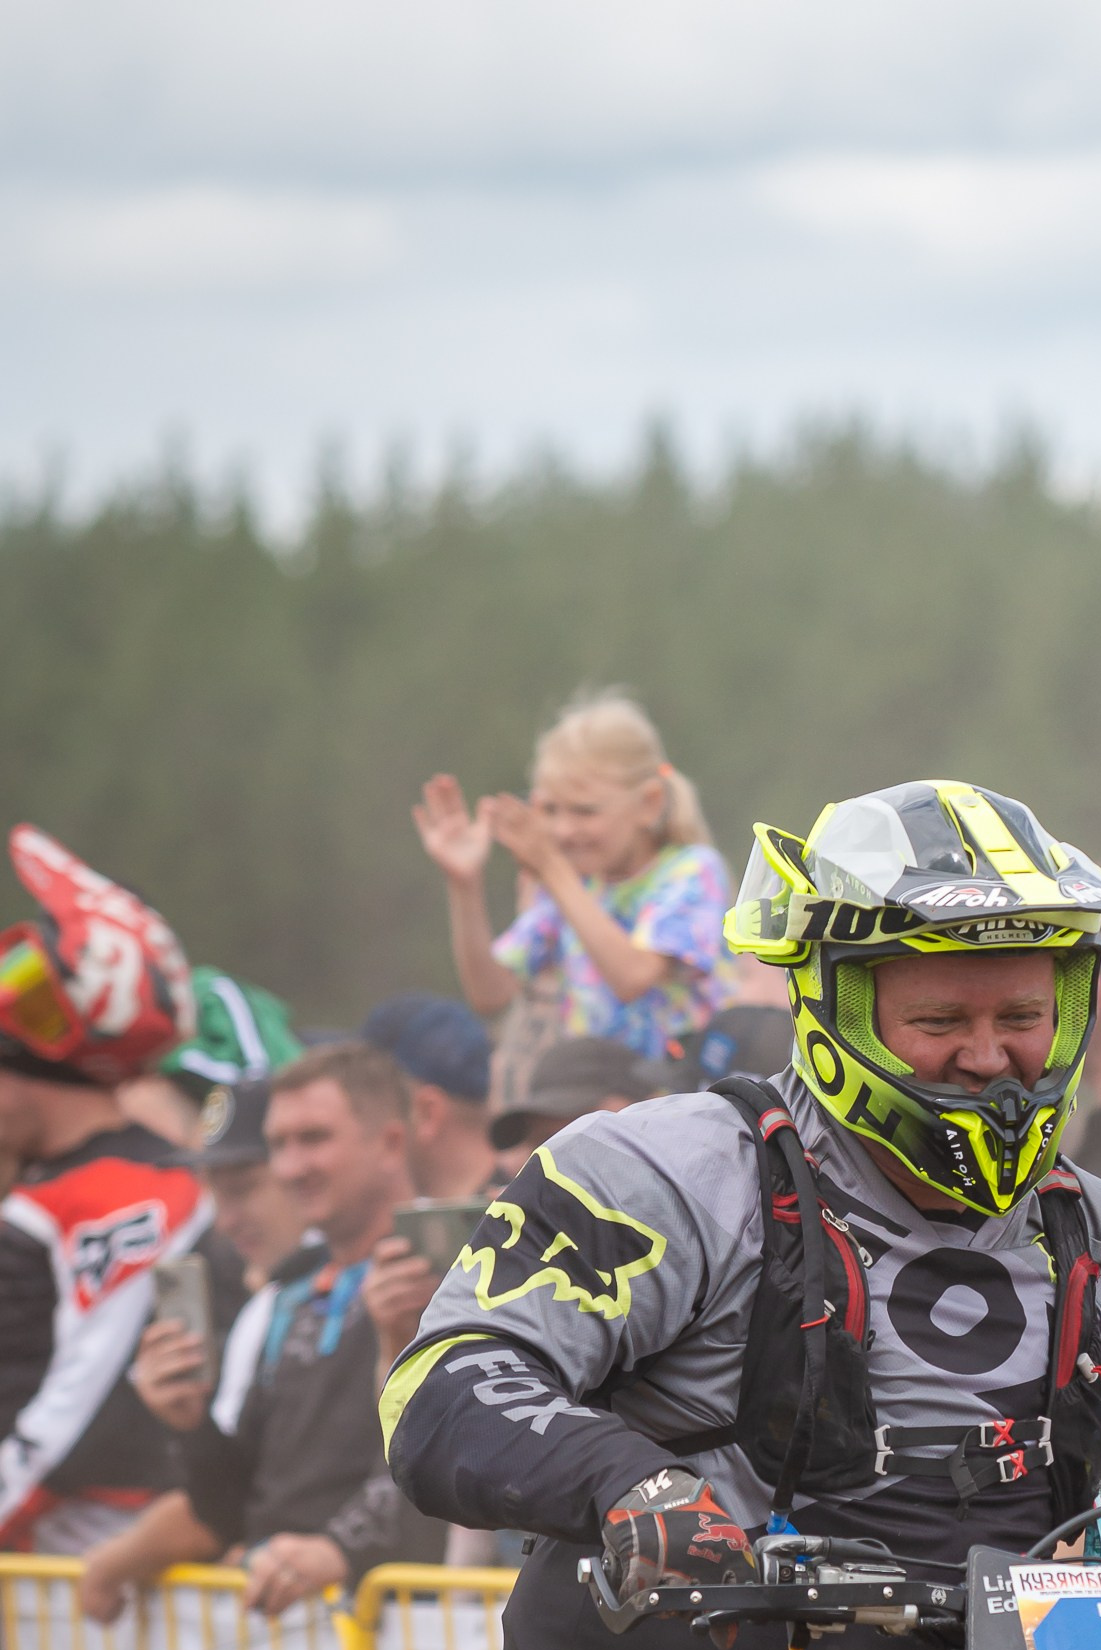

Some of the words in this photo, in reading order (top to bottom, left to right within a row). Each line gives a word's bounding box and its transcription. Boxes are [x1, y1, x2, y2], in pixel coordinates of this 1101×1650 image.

[908, 885, 1009, 908] Airoh
[986, 931, 1028, 941] HELMET
[946, 1129, 974, 1187] AIROH
[445, 1350, 600, 1435] FOX
